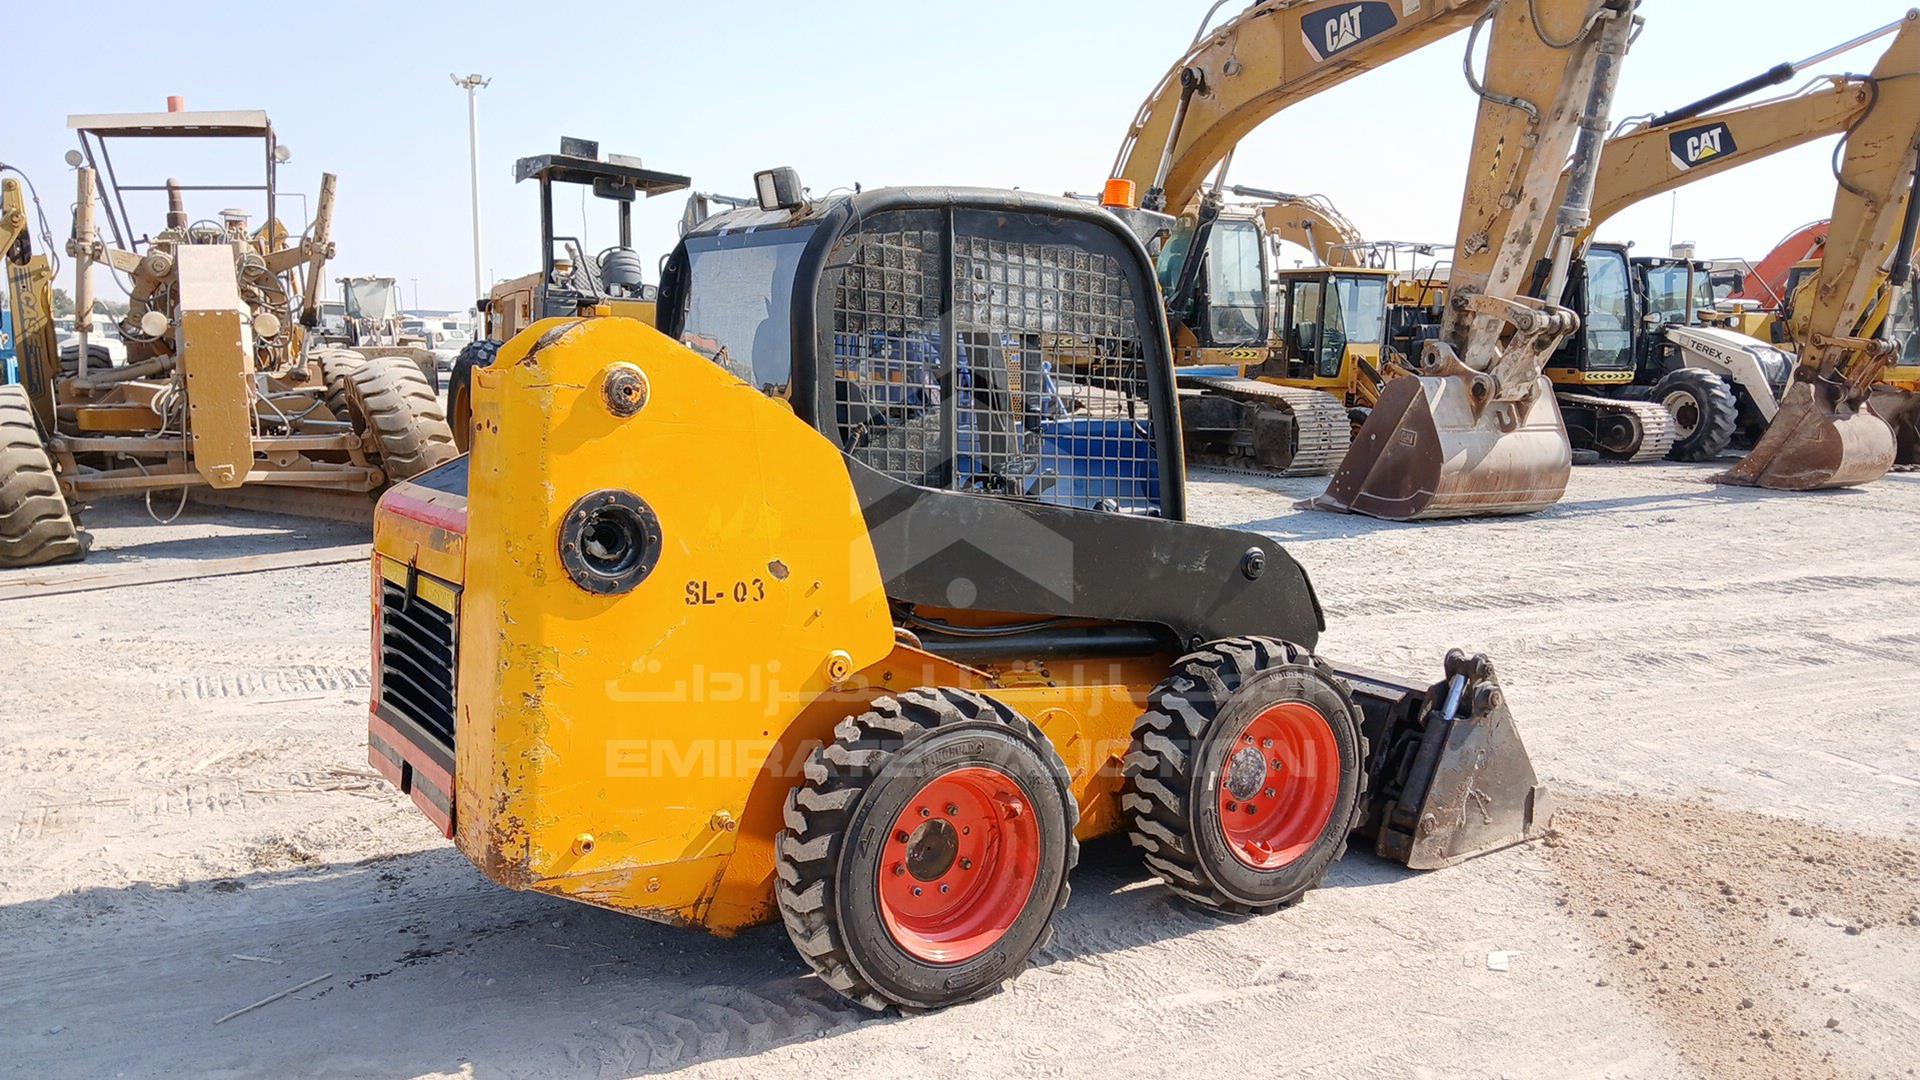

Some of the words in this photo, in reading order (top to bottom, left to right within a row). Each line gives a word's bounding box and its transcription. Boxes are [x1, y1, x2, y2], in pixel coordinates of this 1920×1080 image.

[1325, 4, 1363, 53] CAT
[1686, 126, 1722, 162] CAT
[1690, 339, 1723, 360] TEREX
